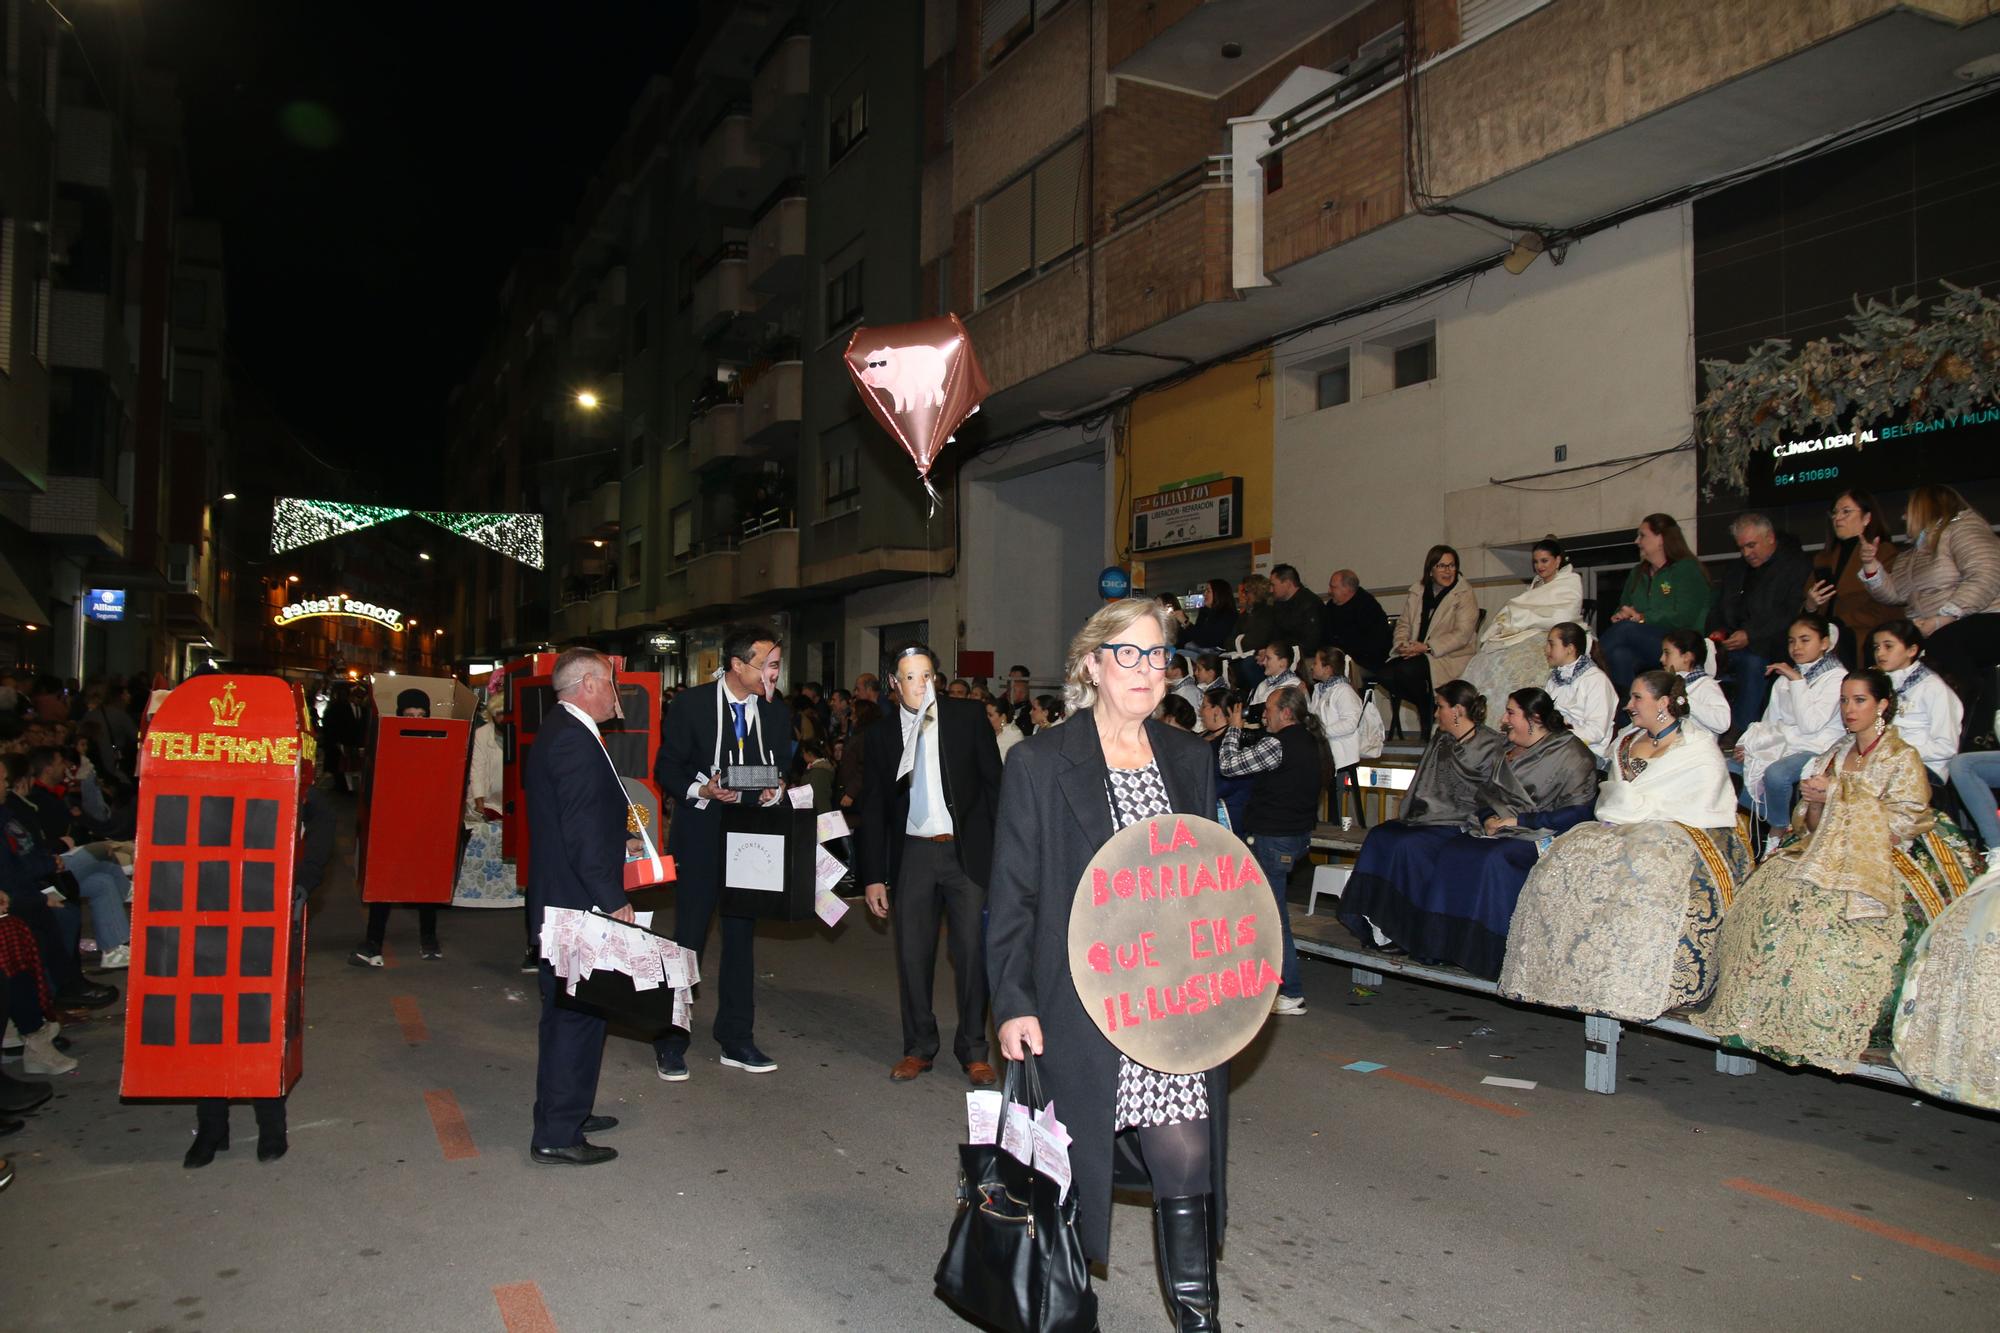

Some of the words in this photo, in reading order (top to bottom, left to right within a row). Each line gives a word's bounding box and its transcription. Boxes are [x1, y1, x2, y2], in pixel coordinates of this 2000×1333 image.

[1949, 415, 1958, 428] Y
[1102, 580, 1128, 588] DIGI
[93, 603, 123, 612] Allianz
[148, 731, 298, 766] TELEPHONE
[1150, 818, 1199, 857] LA
[1091, 854, 1263, 907] BORRIANA
[1087, 931, 1161, 975] QUE
[1189, 913, 1258, 961] ENS
[969, 1101, 982, 1133] 500
